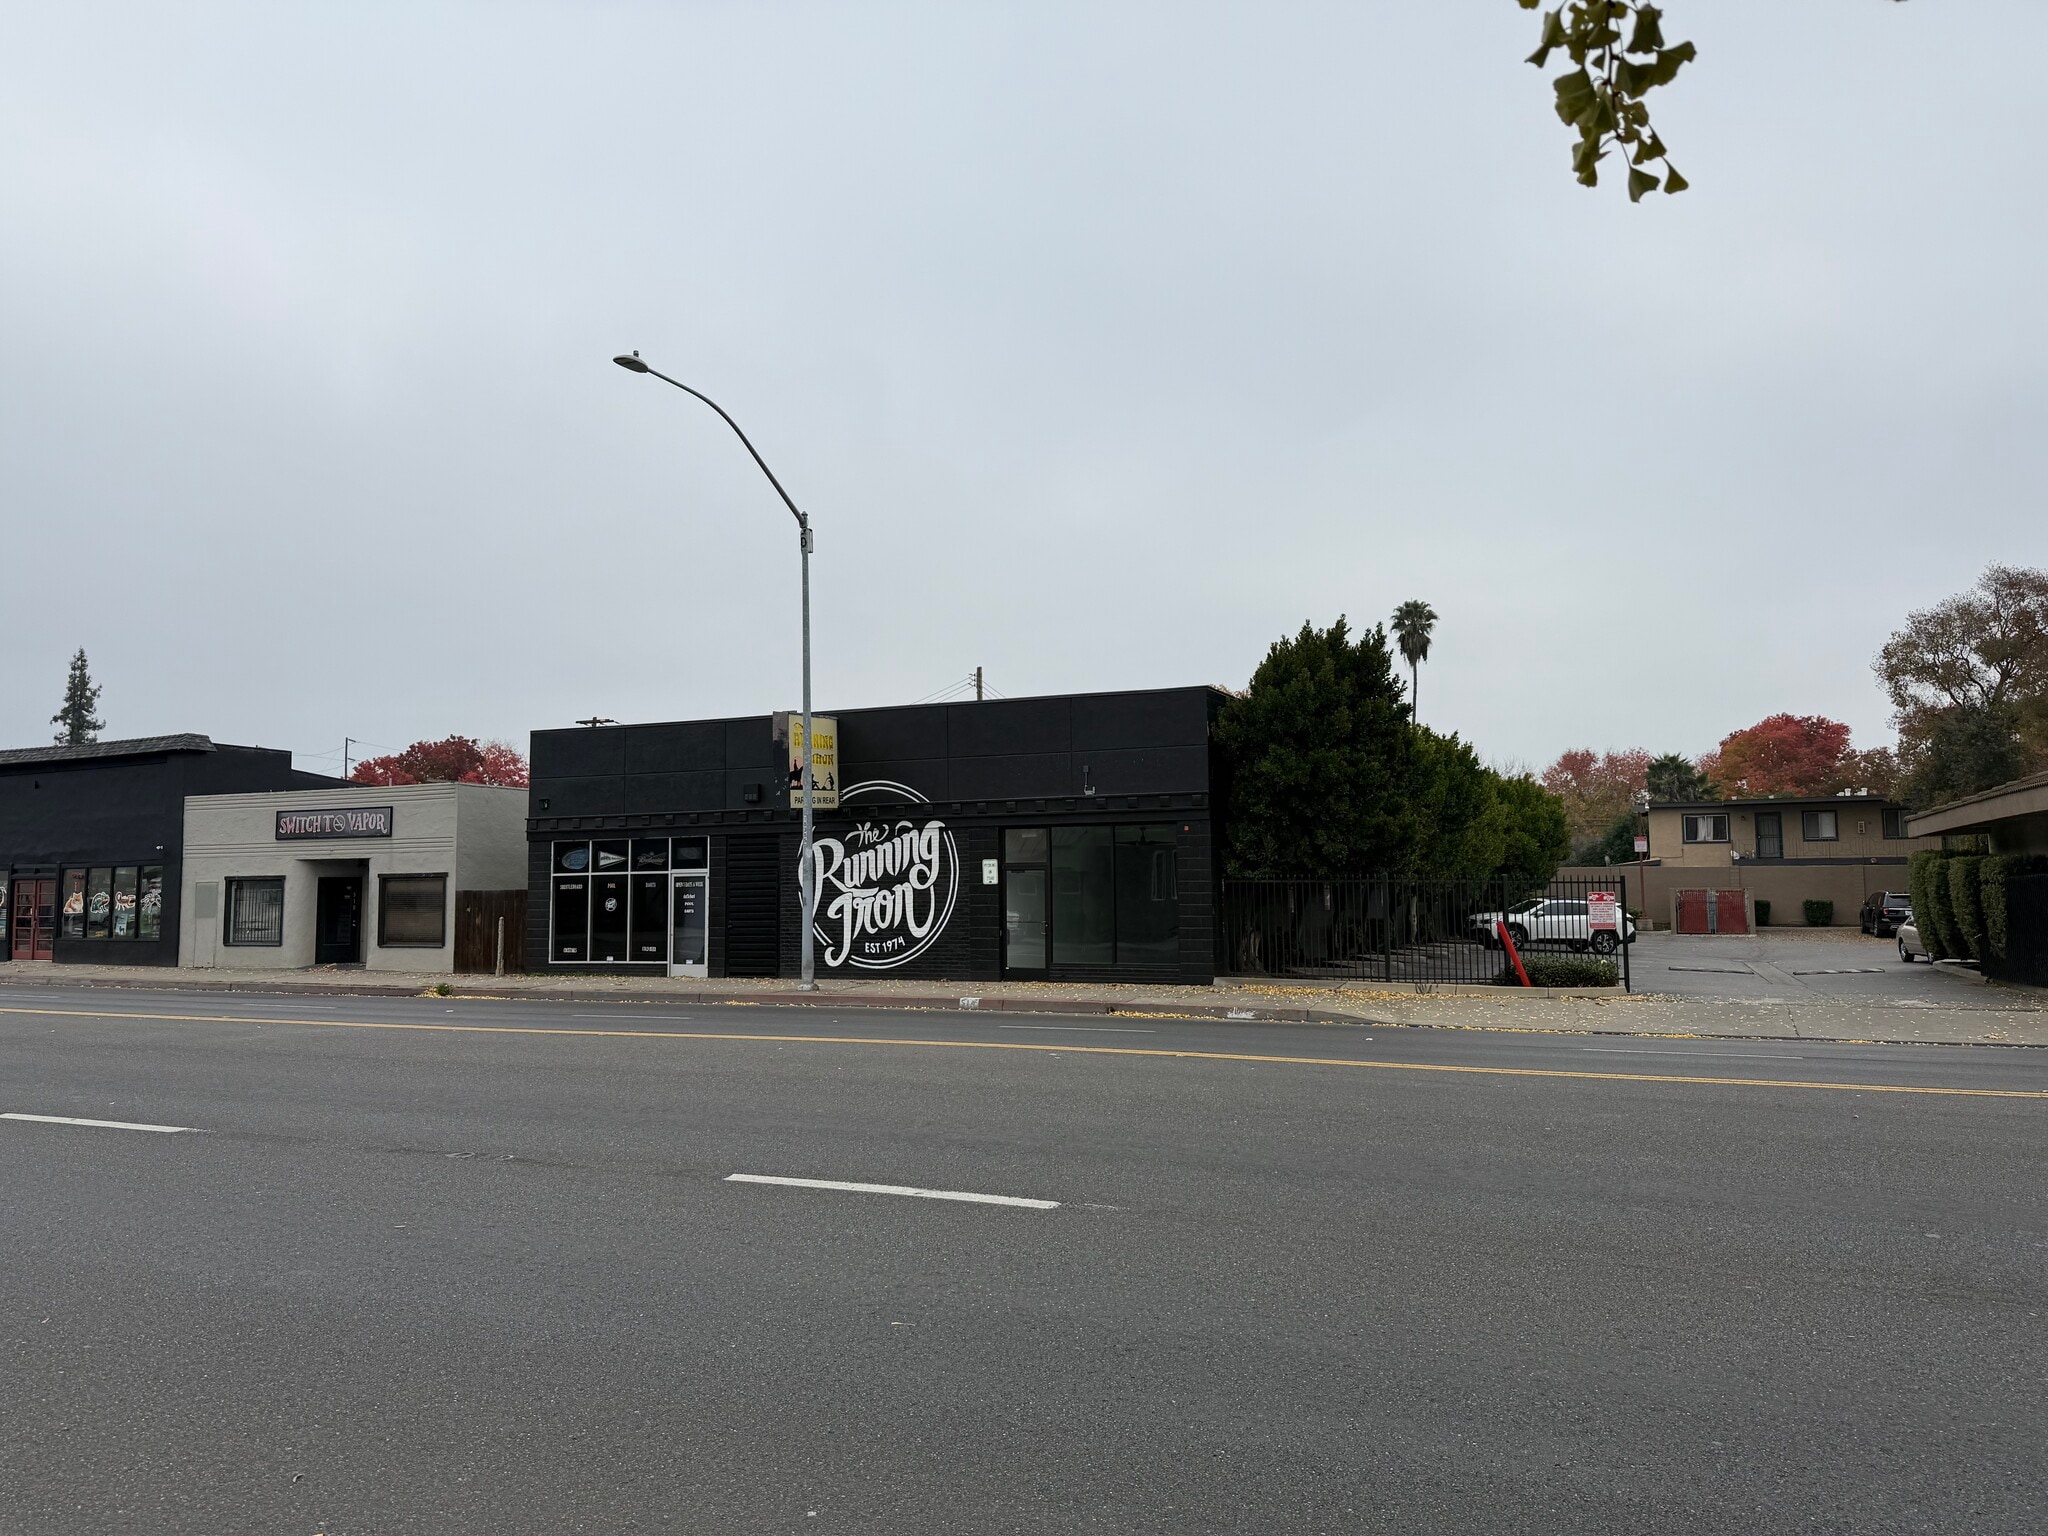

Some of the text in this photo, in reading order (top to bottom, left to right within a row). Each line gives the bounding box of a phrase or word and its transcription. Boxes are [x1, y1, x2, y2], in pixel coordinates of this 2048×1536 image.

[793, 732, 834, 750] RNING
[794, 796, 836, 805] PARG IN REAR
[279, 815, 321, 834] SWITCH
[347, 812, 388, 834] VAPOR
[798, 821, 945, 918] Running
[865, 935, 906, 954] EST 1974
